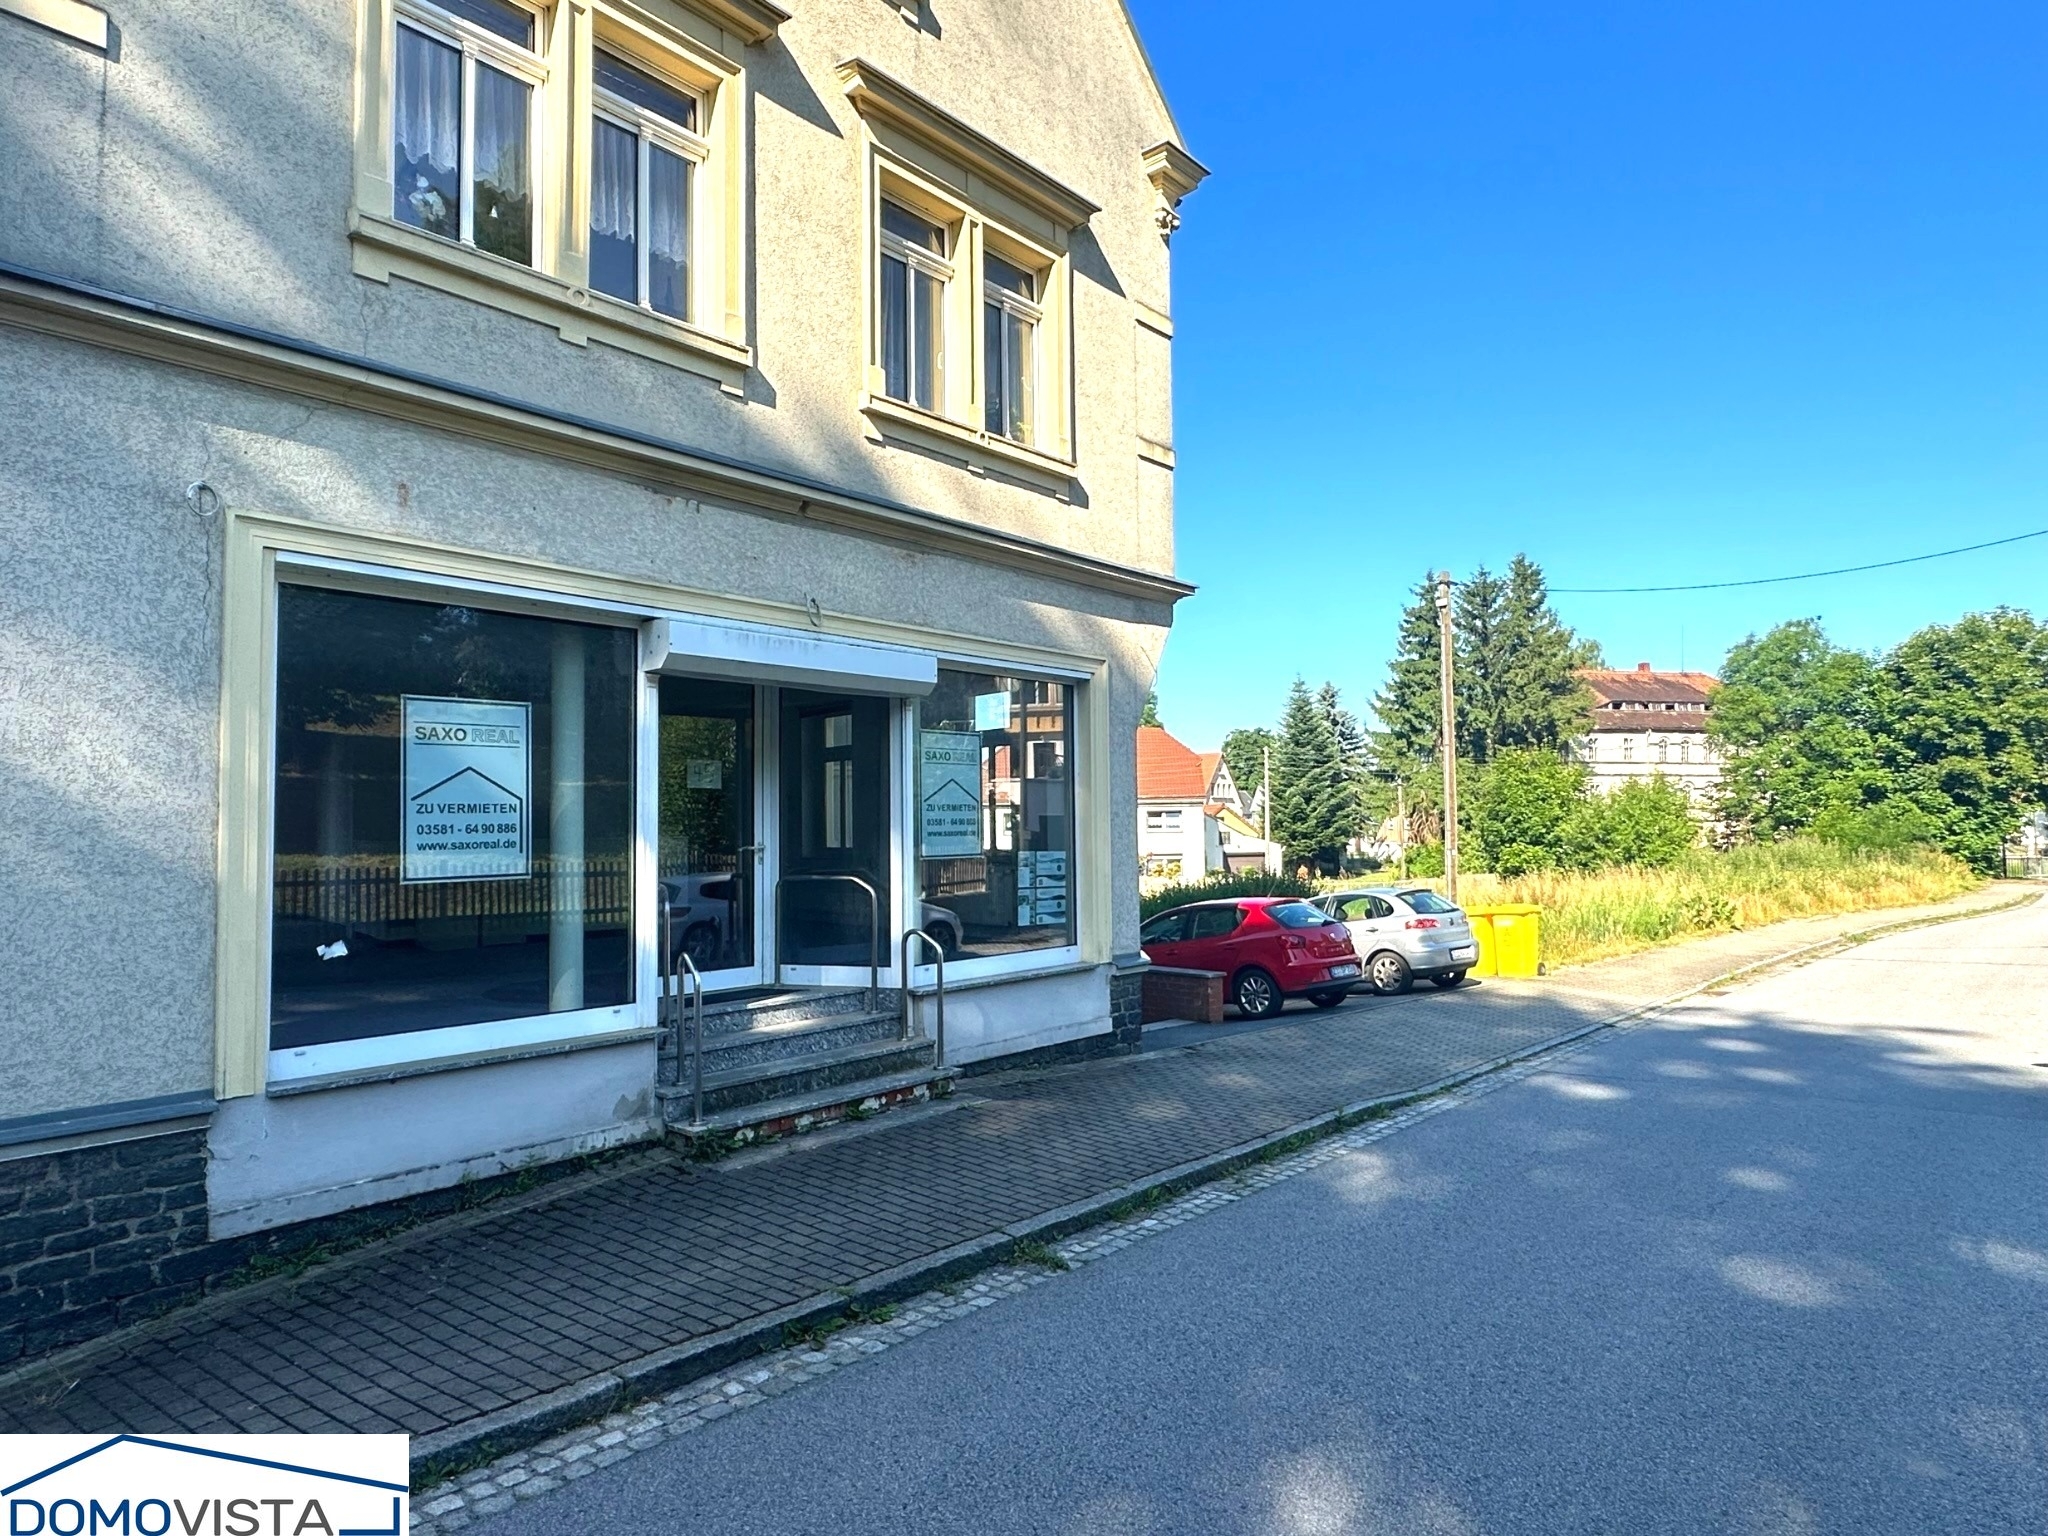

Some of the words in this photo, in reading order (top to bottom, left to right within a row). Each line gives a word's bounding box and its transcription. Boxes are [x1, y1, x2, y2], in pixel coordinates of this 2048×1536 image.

[415, 726, 467, 741] SAXO
[471, 728, 520, 744] REAL
[924, 750, 951, 761] SAXO
[415, 803, 434, 814] ZU
[437, 803, 517, 814] VERMIETEN
[926, 804, 935, 812] ZU
[936, 804, 976, 812] VERMIETEN
[416, 824, 454, 835] 03581
[416, 839, 517, 851] www.saxoreal.de
